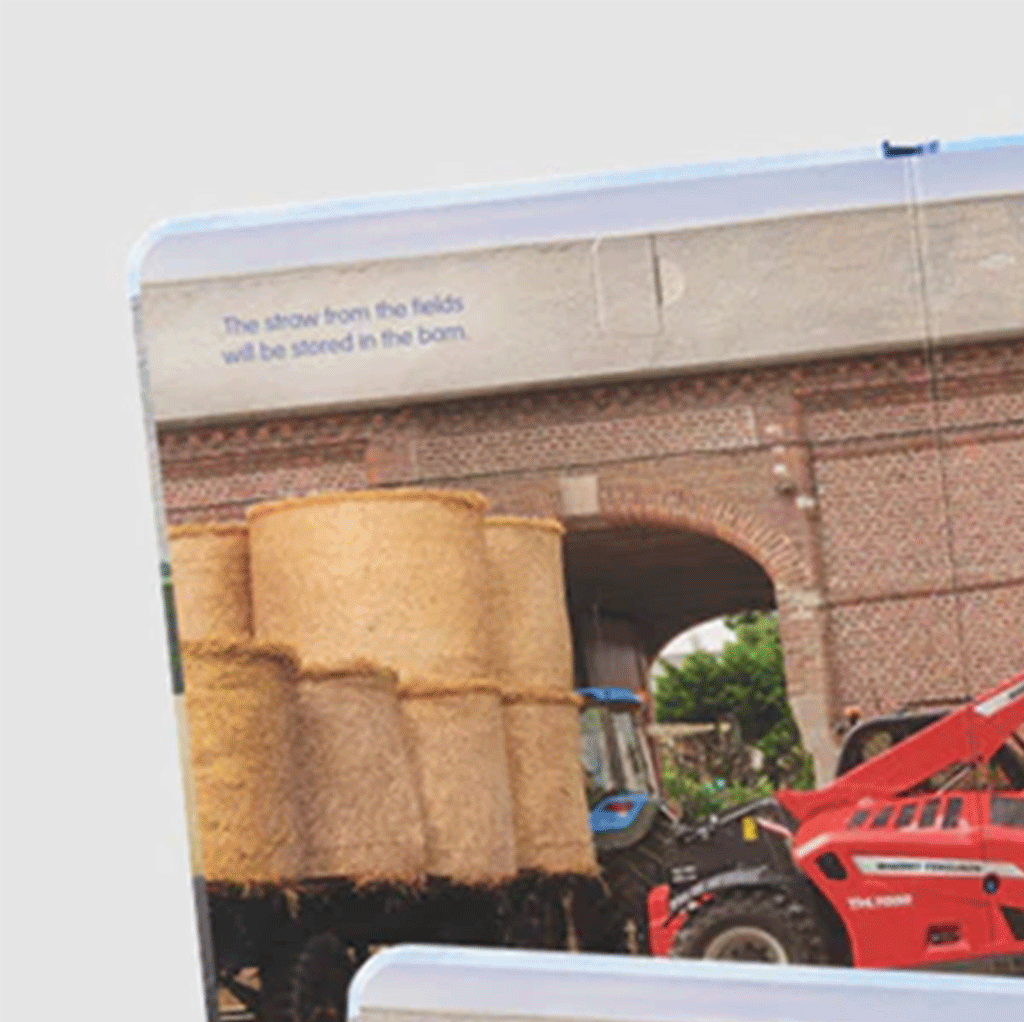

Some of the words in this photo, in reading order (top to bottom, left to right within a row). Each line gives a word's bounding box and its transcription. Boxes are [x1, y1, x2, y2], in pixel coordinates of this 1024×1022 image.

[223, 315, 260, 335] The
[265, 313, 319, 331] straw
[324, 305, 370, 325] from
[375, 300, 408, 319] the
[412, 295, 465, 316] fields
[221, 341, 255, 364] will
[259, 340, 286, 362] be
[291, 331, 354, 358] stored
[358, 332, 377, 350] in
[381, 328, 413, 348] the
